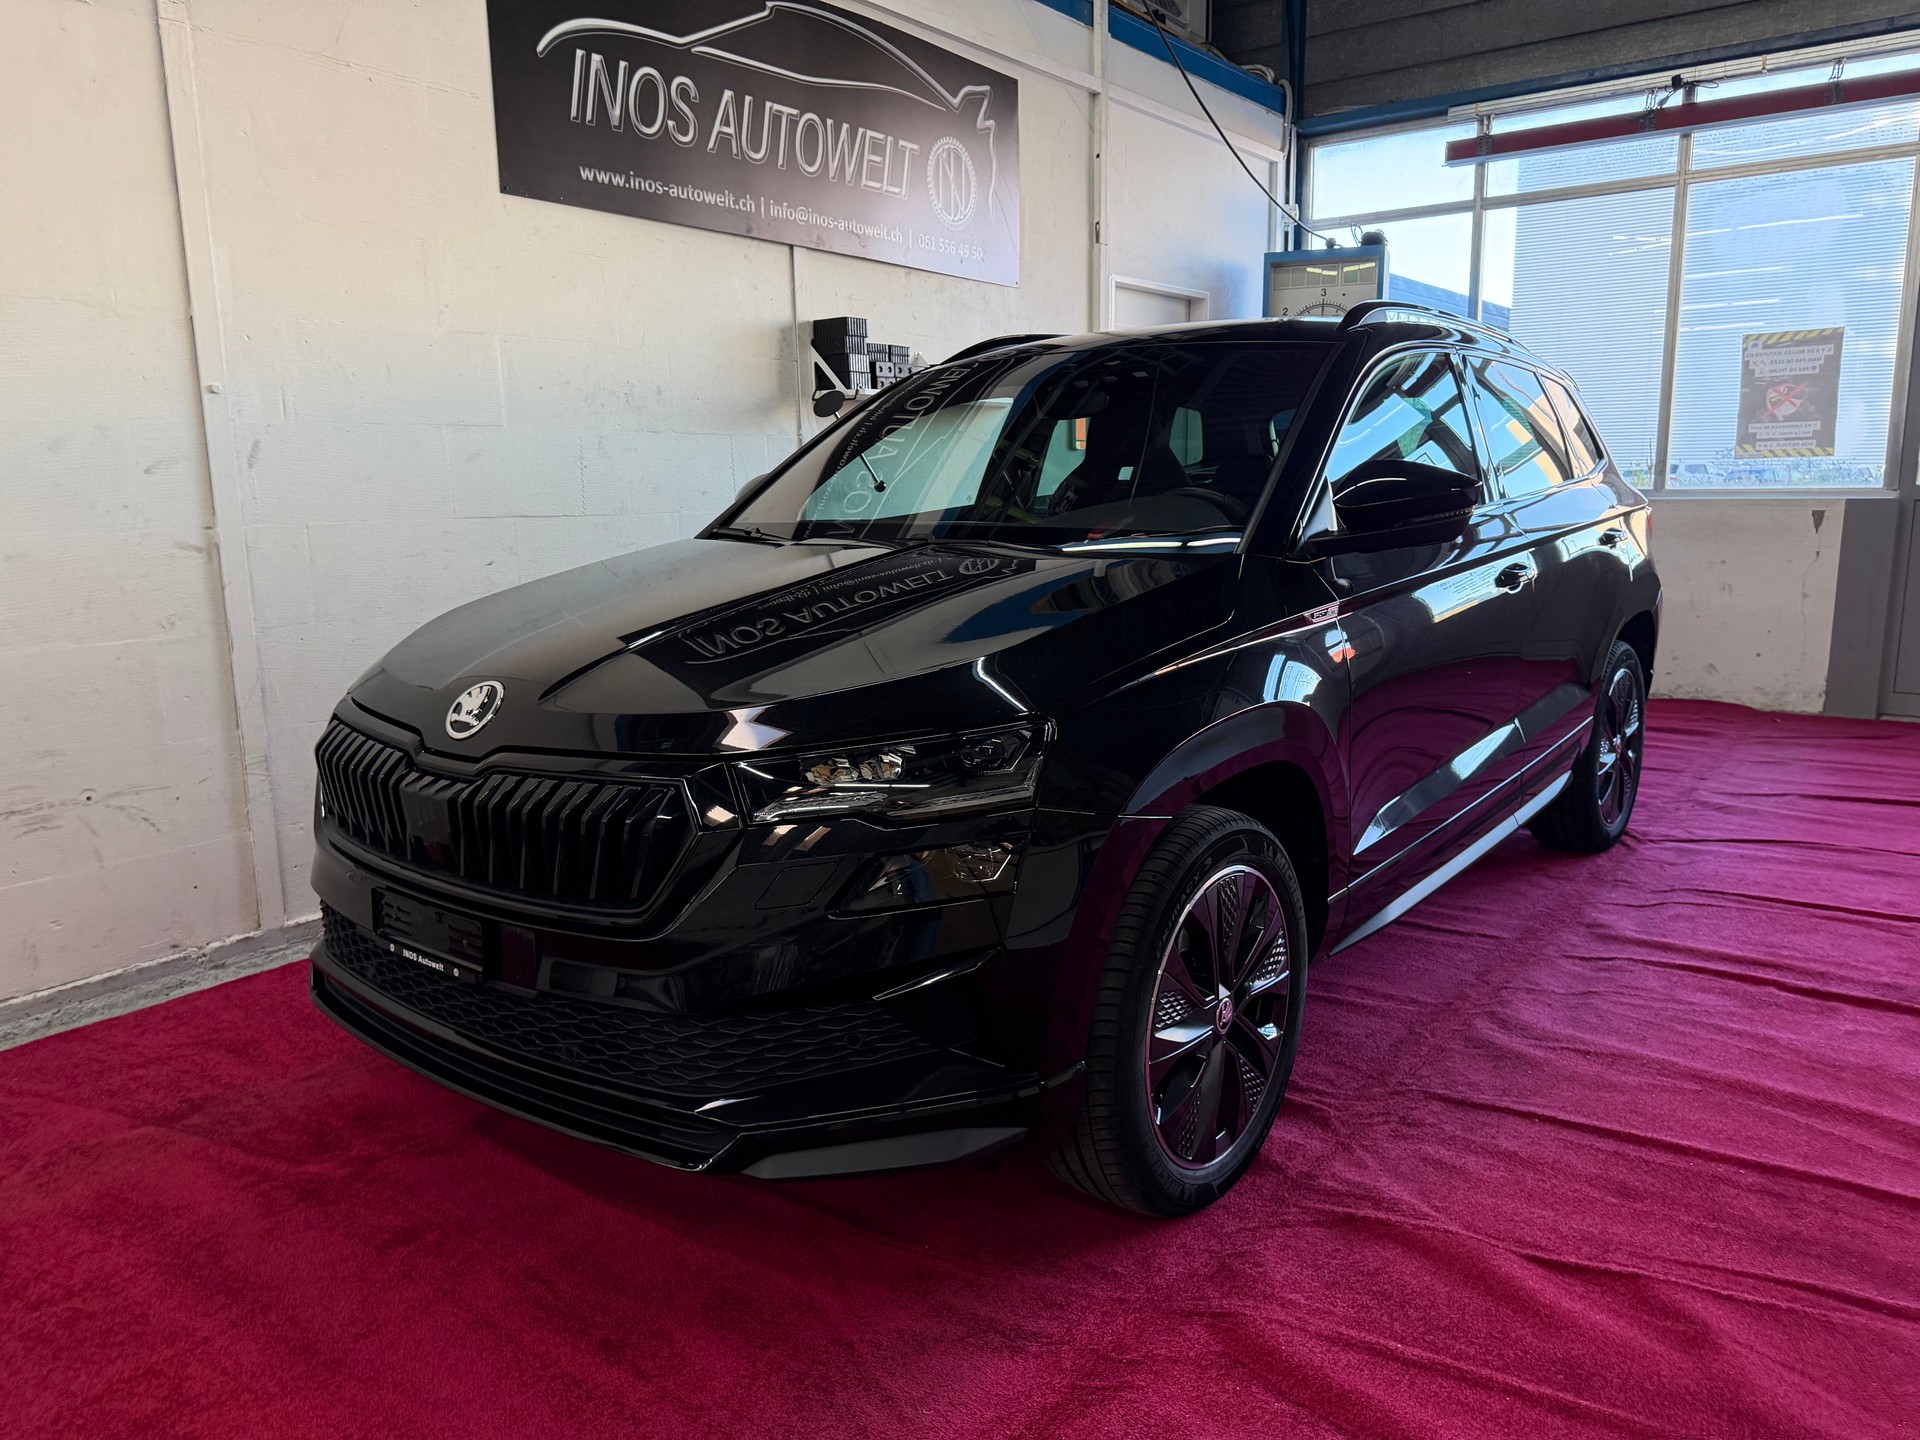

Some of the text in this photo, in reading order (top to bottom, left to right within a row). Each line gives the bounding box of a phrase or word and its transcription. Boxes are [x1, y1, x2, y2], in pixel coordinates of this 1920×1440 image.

[571, 49, 699, 147] INOS
[707, 89, 919, 199] AUTOWELT
[579, 166, 755, 213] www.inos-autowelt.ch
[770, 200, 903, 243] info@inos-autowelt.ch
[939, 238, 956, 255] 556
[957, 243, 970, 258] 49
[971, 245, 983, 260] 50
[1320, 288, 1327, 297] 3
[1282, 307, 1289, 316] 2
[402, 948, 444, 972] INOS Autowelt
